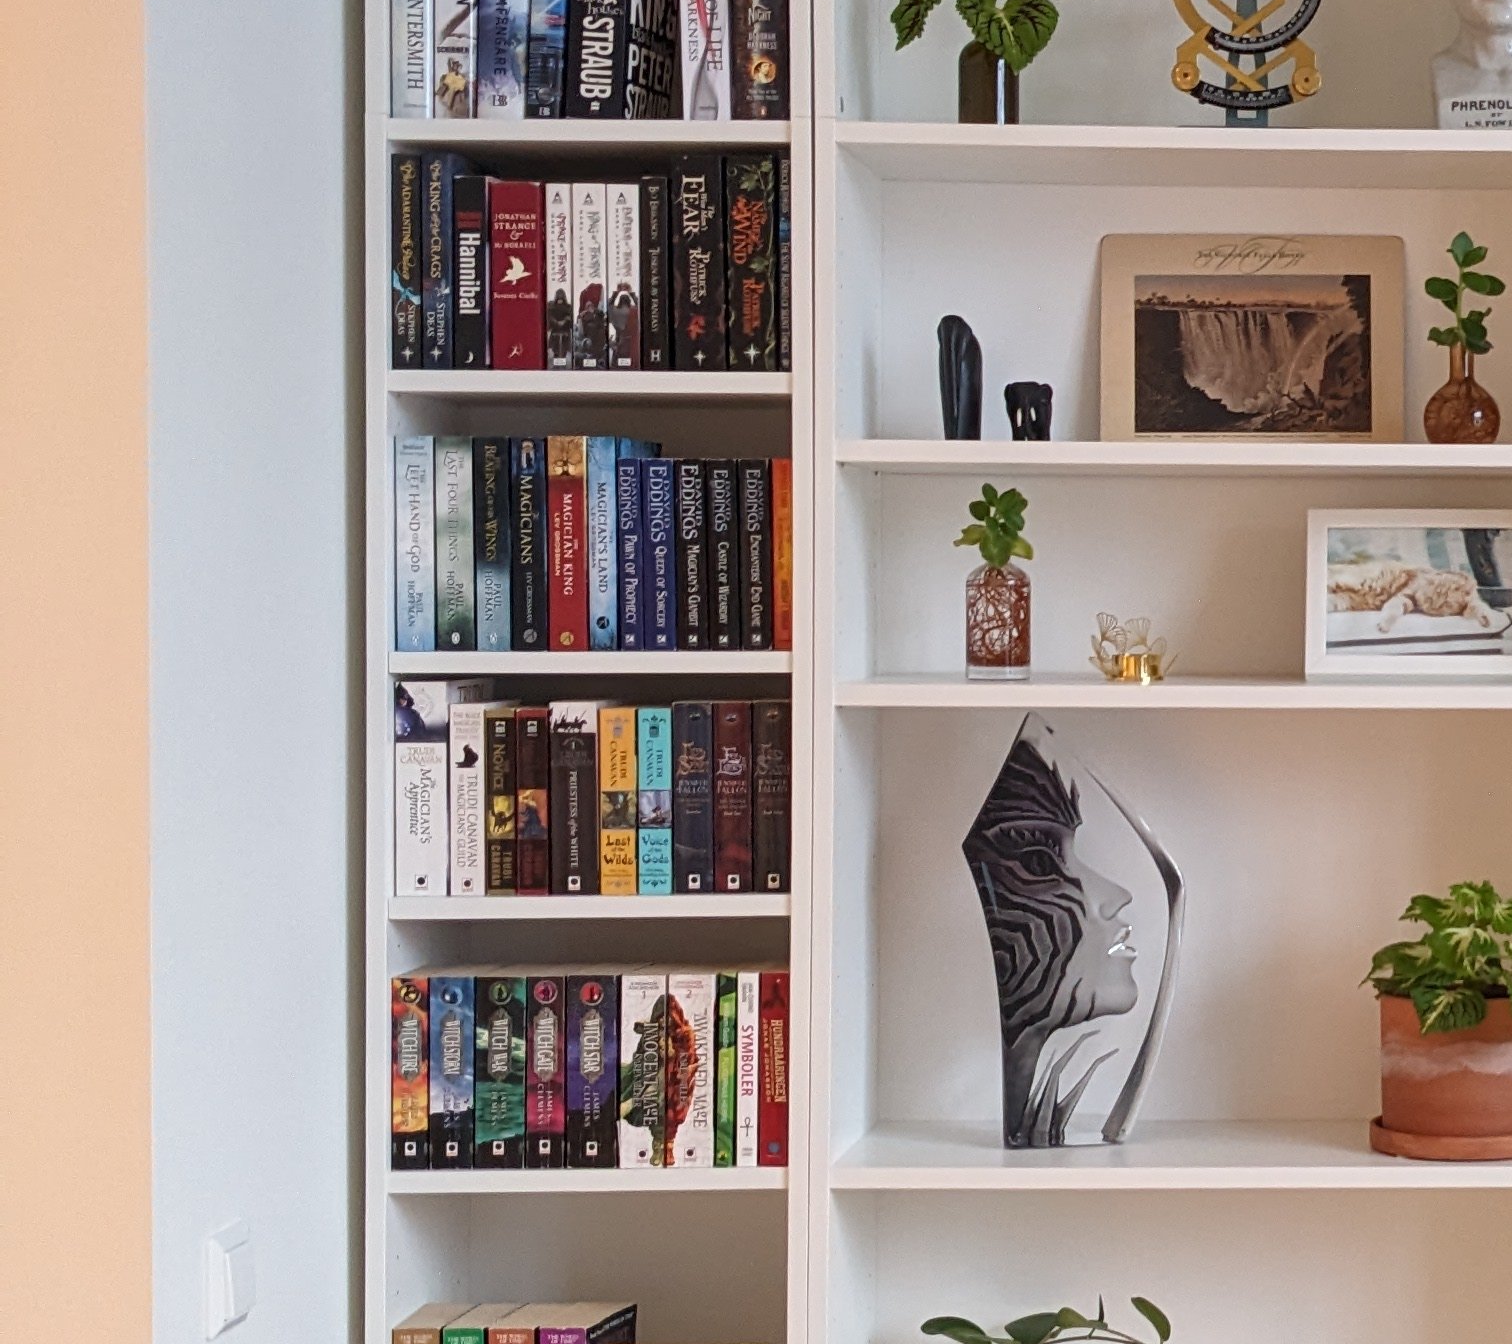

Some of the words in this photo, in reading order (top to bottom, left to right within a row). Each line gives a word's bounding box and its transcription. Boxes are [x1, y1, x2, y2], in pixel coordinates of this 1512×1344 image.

[579, 17, 616, 100] STRAUB
[682, 174, 705, 236] FEAR
[494, 222, 537, 231] STRANGE
[459, 233, 481, 315] Hannibal
[408, 493, 420, 532] HAND
[447, 483, 458, 515] FOUR
[620, 466, 634, 530] EDDINGS
[649, 465, 667, 542] EDDINGS
[681, 464, 700, 540] EDDINGS
[713, 469, 728, 533] EDDINGS
[746, 469, 760, 532] EDDINGS
[520, 475, 533, 564] MAGICIANS
[562, 493, 573, 558] MAGICIAN
[597, 482, 608, 554] MAGICIAN'S
[625, 534, 638, 560] PAWN
[562, 562, 573, 596] KING
[597, 557, 608, 593] LAND
[454, 583, 464, 607] PAUL
[493, 583, 502, 607] PAUL
[625, 578, 638, 625] PROPHECY
[656, 591, 667, 628] SORCERY
[688, 595, 700, 627] GAMBIT
[718, 586, 730, 625] WIZARDRY
[420, 769, 432, 844] MAGICIAN'S
[467, 774, 478, 812] TRUDI
[467, 814, 479, 869] CANAVAN
[569, 836, 580, 868] WHITE
[444, 1020, 461, 1048] WITCH
[491, 1019, 509, 1051] WITCH
[537, 1018, 554, 1049] WITCH
[584, 1018, 601, 1050] WITCH
[401, 1052, 419, 1074] FIRE
[537, 1049, 554, 1073] GATE
[583, 1051, 601, 1074] STAR
[741, 1025, 755, 1096] SYMBOLER
